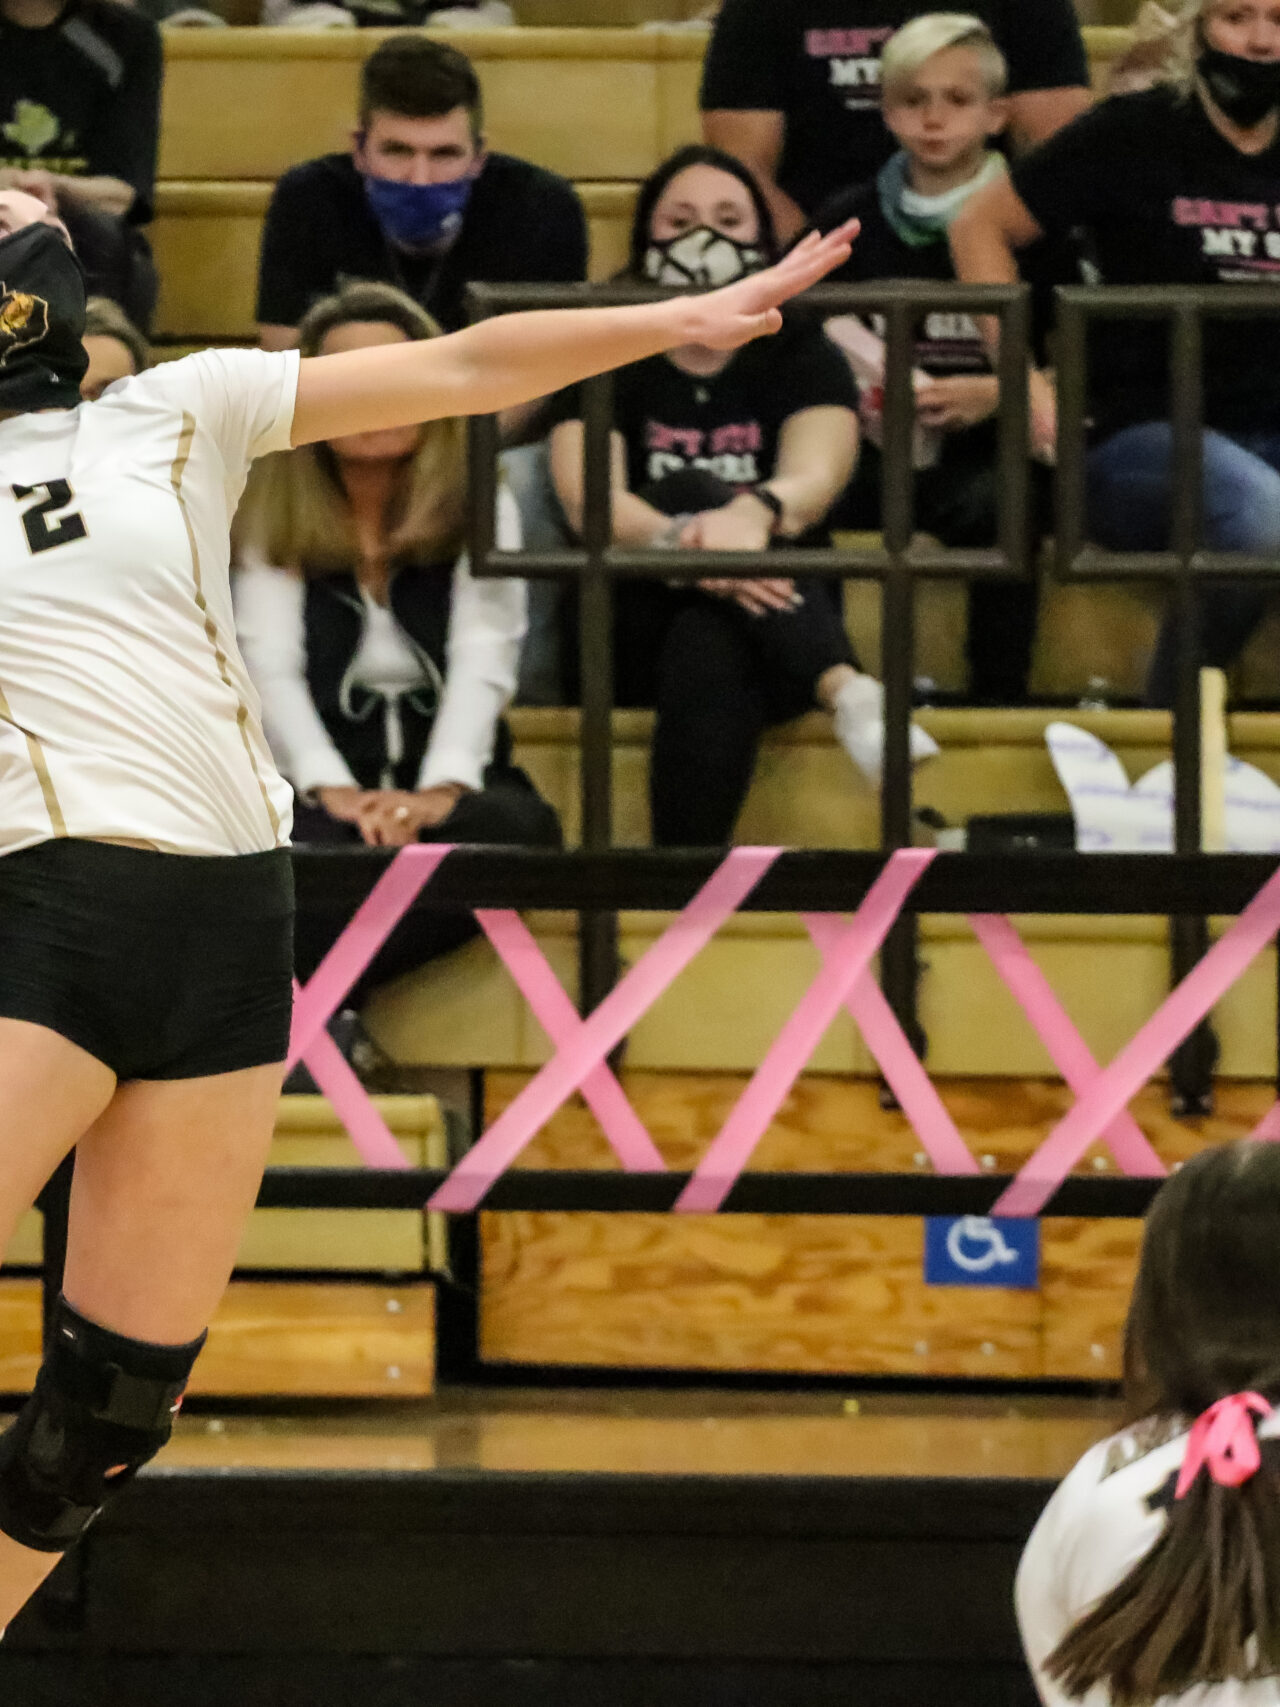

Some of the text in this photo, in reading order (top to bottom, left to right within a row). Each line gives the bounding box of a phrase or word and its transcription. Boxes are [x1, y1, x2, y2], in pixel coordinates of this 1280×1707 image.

[829, 58, 881, 86] MY
[1202, 228, 1257, 257] MY
[10, 478, 88, 555] 2
